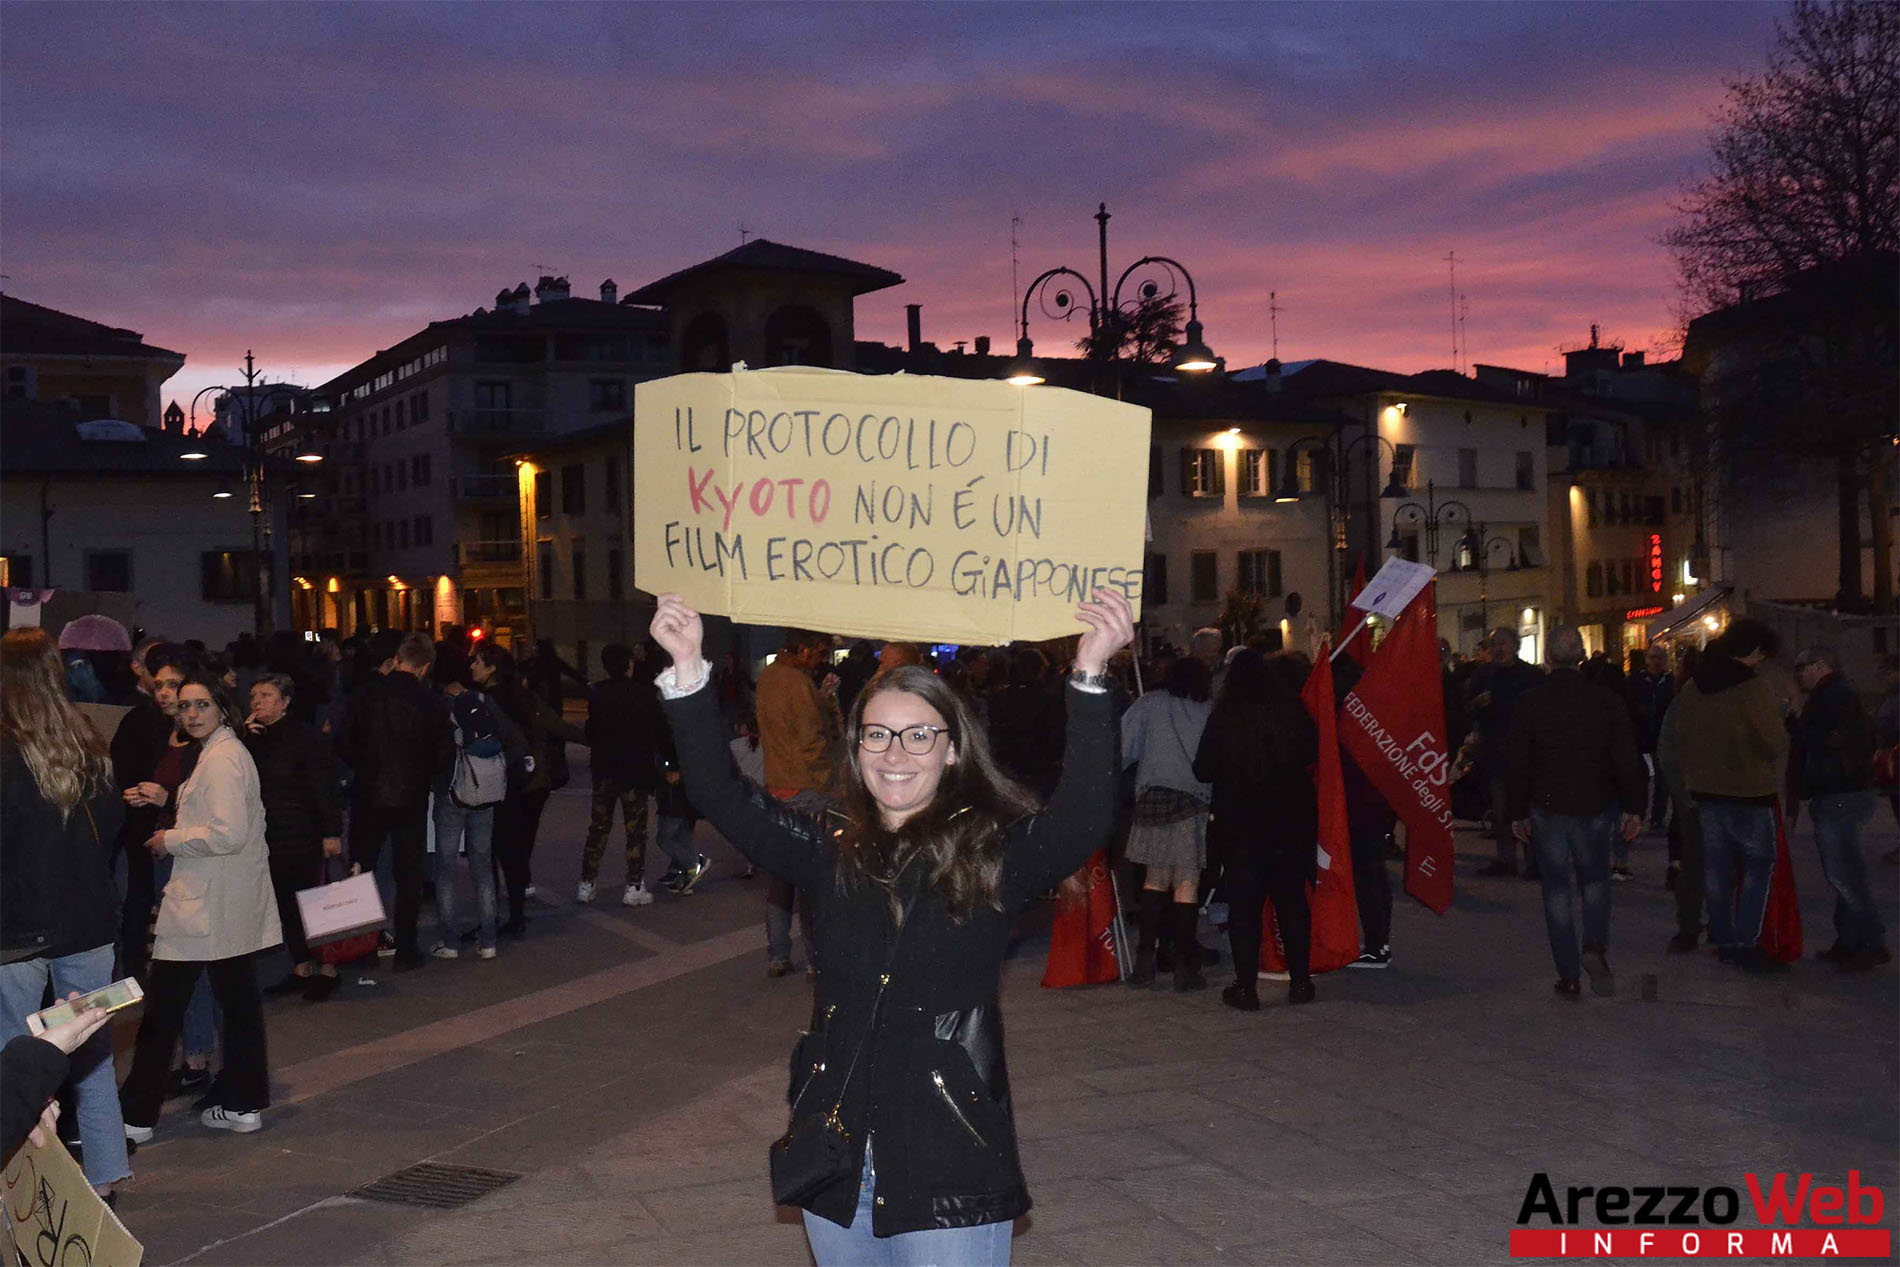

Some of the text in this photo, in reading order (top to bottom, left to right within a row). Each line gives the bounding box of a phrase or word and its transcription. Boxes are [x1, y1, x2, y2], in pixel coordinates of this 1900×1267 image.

[675, 406, 1050, 476] IL PROTOCOLLO DI
[854, 479, 933, 529] NON
[992, 492, 1042, 540] UN
[665, 520, 748, 581] FILM
[1343, 690, 1419, 781] FEDERAZIONE
[1412, 778, 1446, 814] degli
